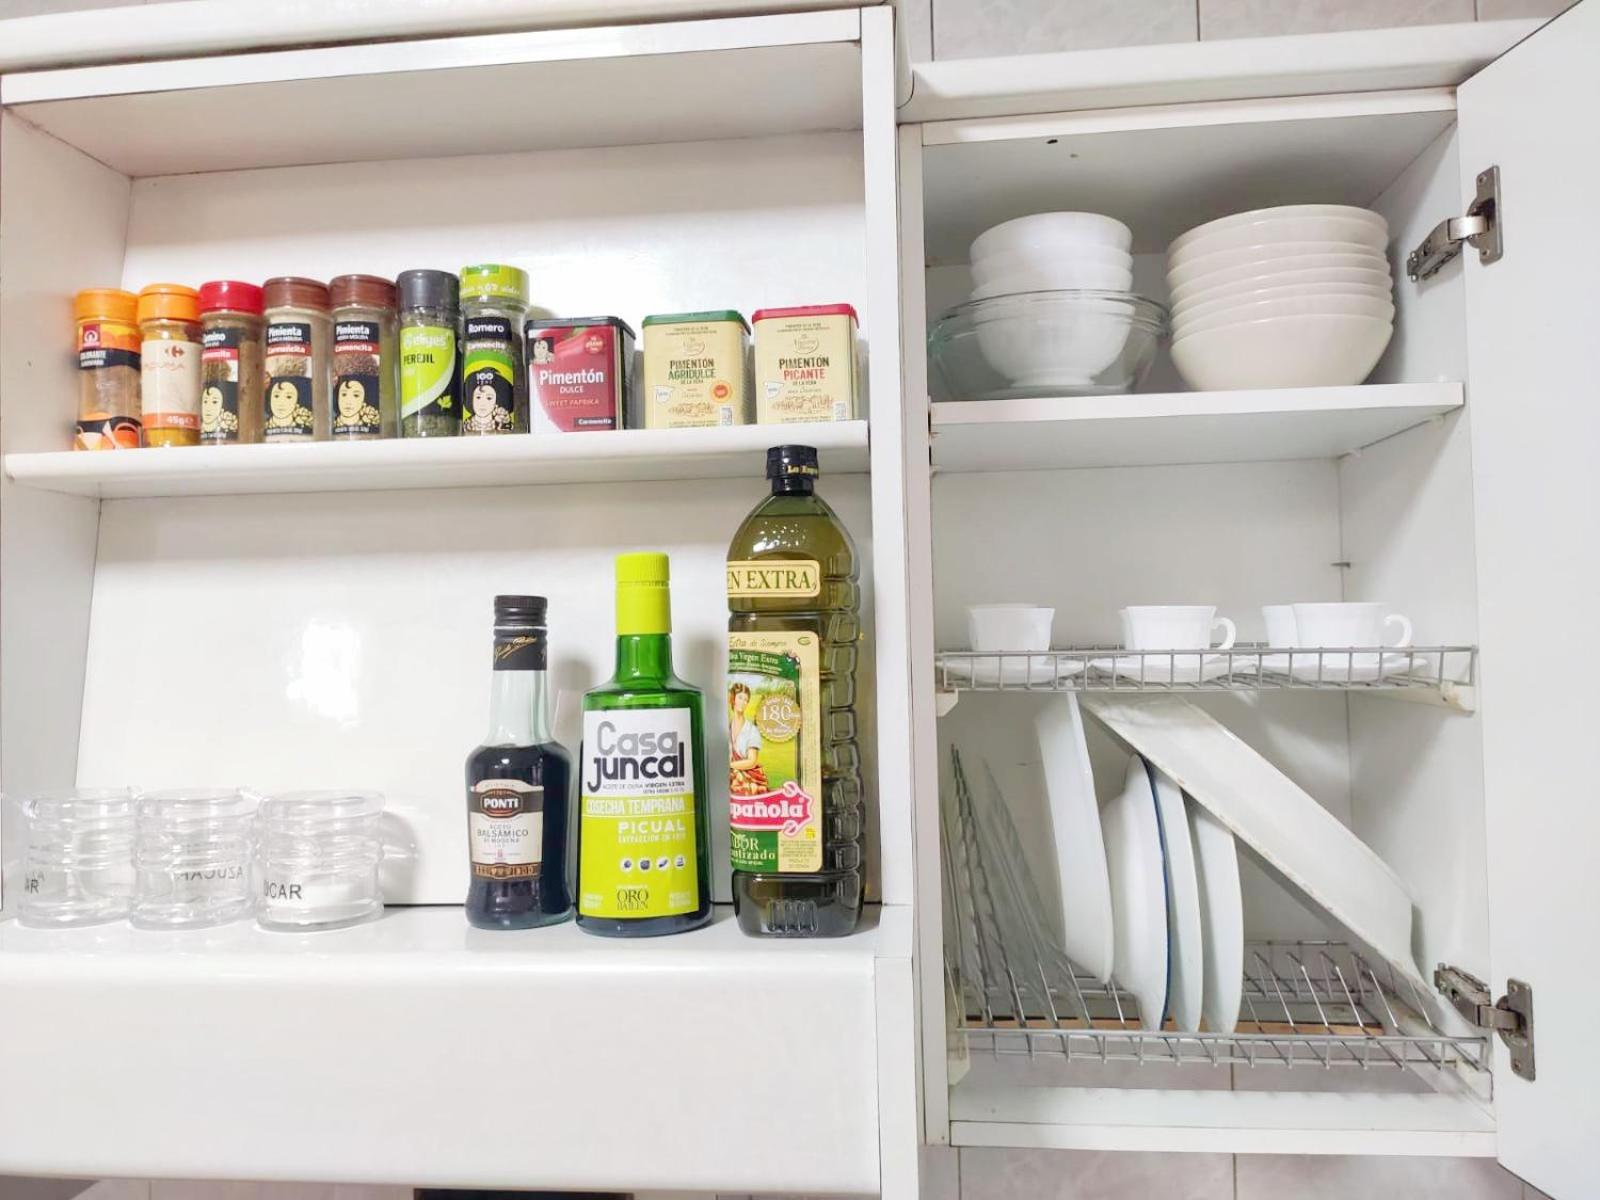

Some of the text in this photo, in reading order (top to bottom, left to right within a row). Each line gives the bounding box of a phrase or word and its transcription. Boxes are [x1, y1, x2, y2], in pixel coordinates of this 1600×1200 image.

[268, 326, 303, 337] Pimienta
[336, 325, 370, 335] Pimienta
[468, 324, 505, 334] Romero
[202, 332, 226, 343] omino
[404, 354, 435, 365] PEREJIL
[540, 368, 604, 386] Pimentón
[667, 368, 716, 380] AGRIDULCE
[783, 368, 826, 380] PICANTE
[559, 386, 584, 394] DULCE
[746, 570, 812, 589] EXTRA
[763, 704, 792, 722] 180
[597, 721, 678, 756] Casa
[587, 742, 685, 793] juncal
[483, 798, 519, 808] PONTI
[730, 800, 804, 819] pañola
[618, 819, 686, 834] PICUAL
[616, 889, 650, 902] ORO
